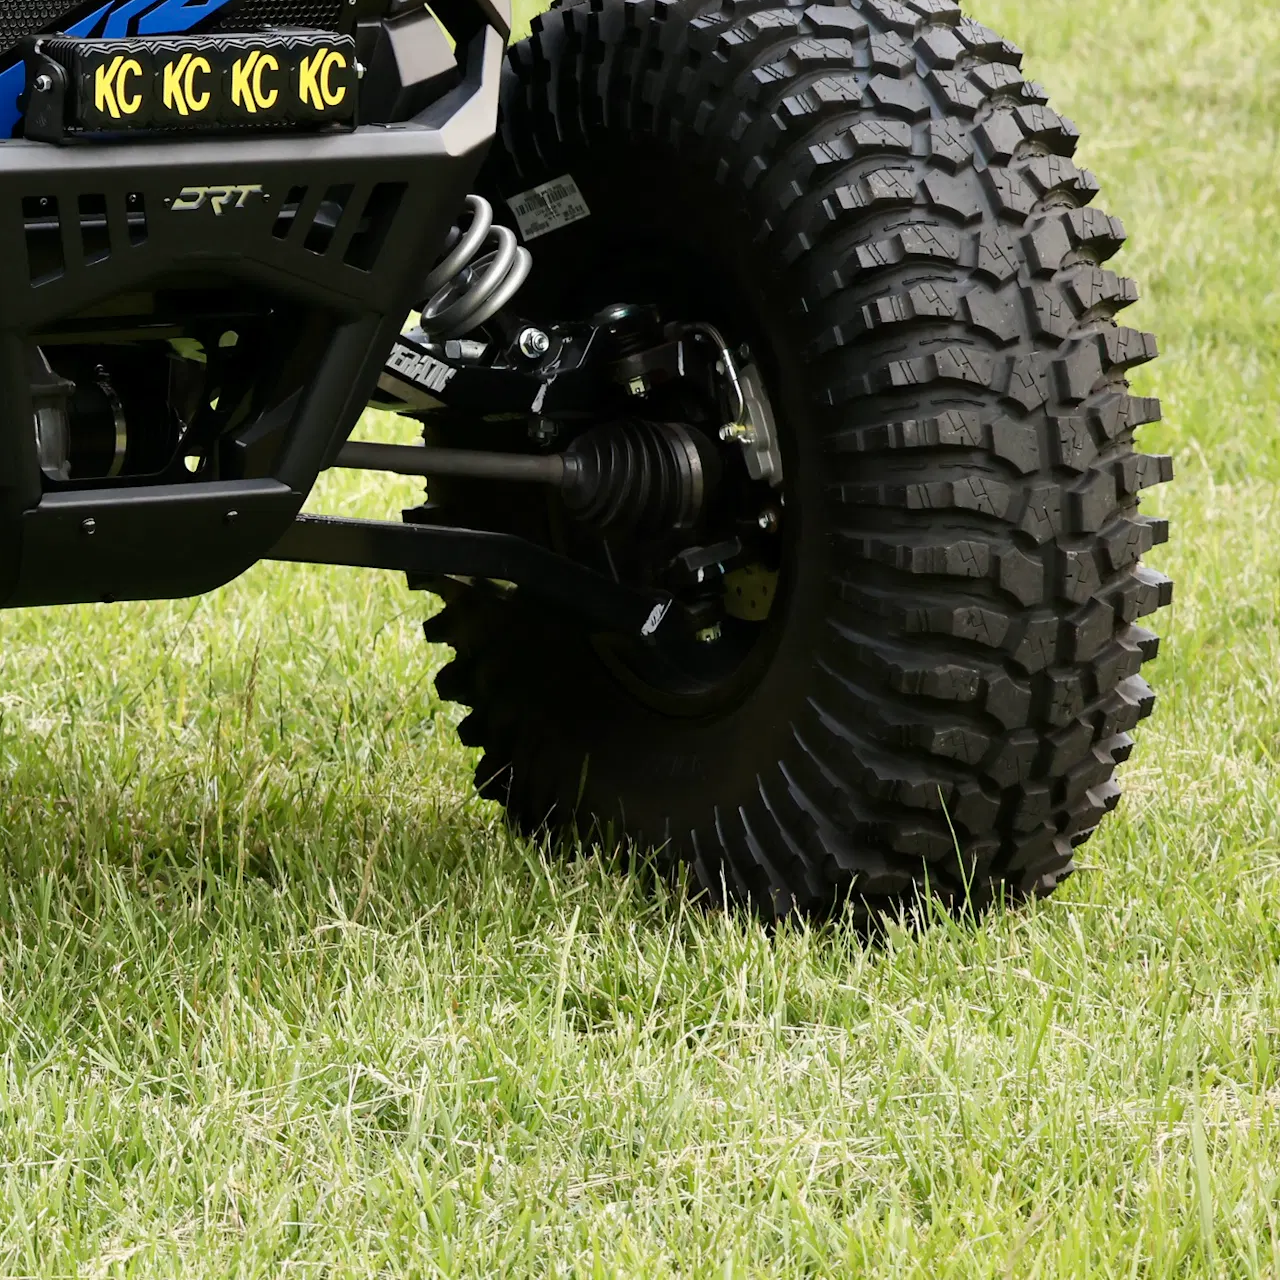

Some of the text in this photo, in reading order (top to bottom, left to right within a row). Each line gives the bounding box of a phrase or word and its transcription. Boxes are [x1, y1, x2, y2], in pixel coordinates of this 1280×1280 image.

[94, 47, 347, 119] KC KC KC KC
[171, 185, 262, 216] DRT
